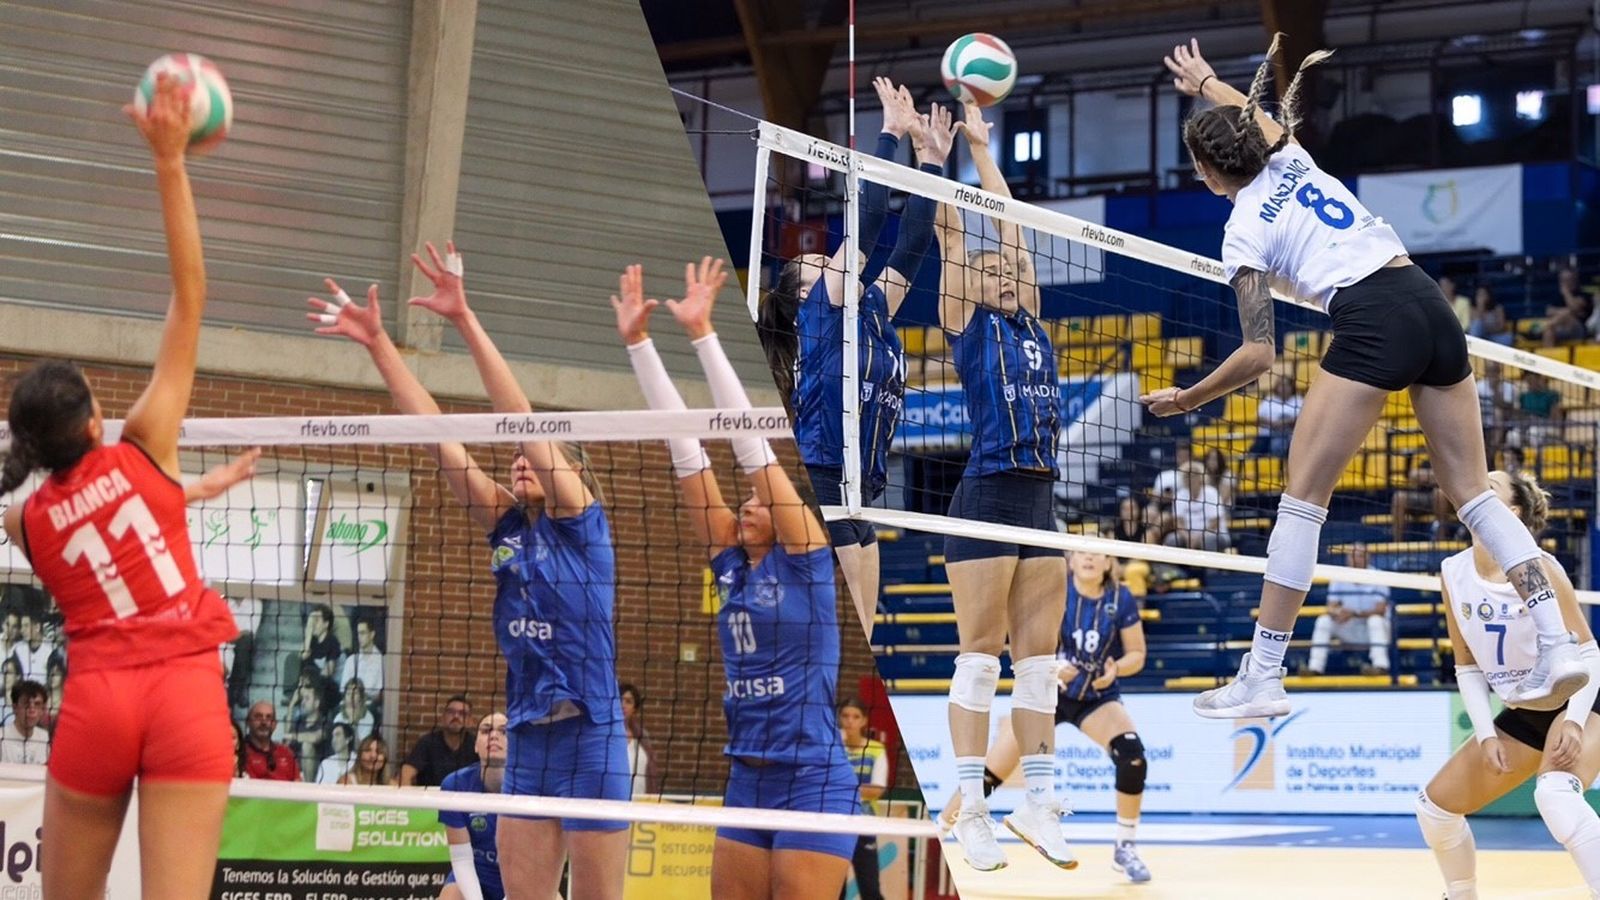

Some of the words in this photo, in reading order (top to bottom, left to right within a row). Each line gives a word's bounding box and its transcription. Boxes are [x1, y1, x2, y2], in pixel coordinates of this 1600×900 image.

[1296, 182, 1355, 230] 8
[1022, 339, 1043, 371] 9
[301, 420, 370, 437] rfevb.com
[496, 417, 572, 434] rfevb.com
[48, 467, 132, 532] BLANCA
[61, 493, 187, 620] 11
[1072, 629, 1100, 653] 18
[1484, 624, 1507, 666] 7
[1286, 743, 1344, 759] Instituto
[1350, 743, 1421, 762] Municipal
[1308, 762, 1376, 779] Deportes
[358, 810, 409, 826] SIGES
[357, 830, 448, 847] SOLUTION
[222, 867, 274, 884] Tenemos
[277, 868, 289, 884] la
[292, 867, 341, 885] Solución
[343, 870, 359, 885] de
[361, 869, 405, 886] Gestión
[407, 873, 430, 888] que
[431, 873, 445, 885] su
